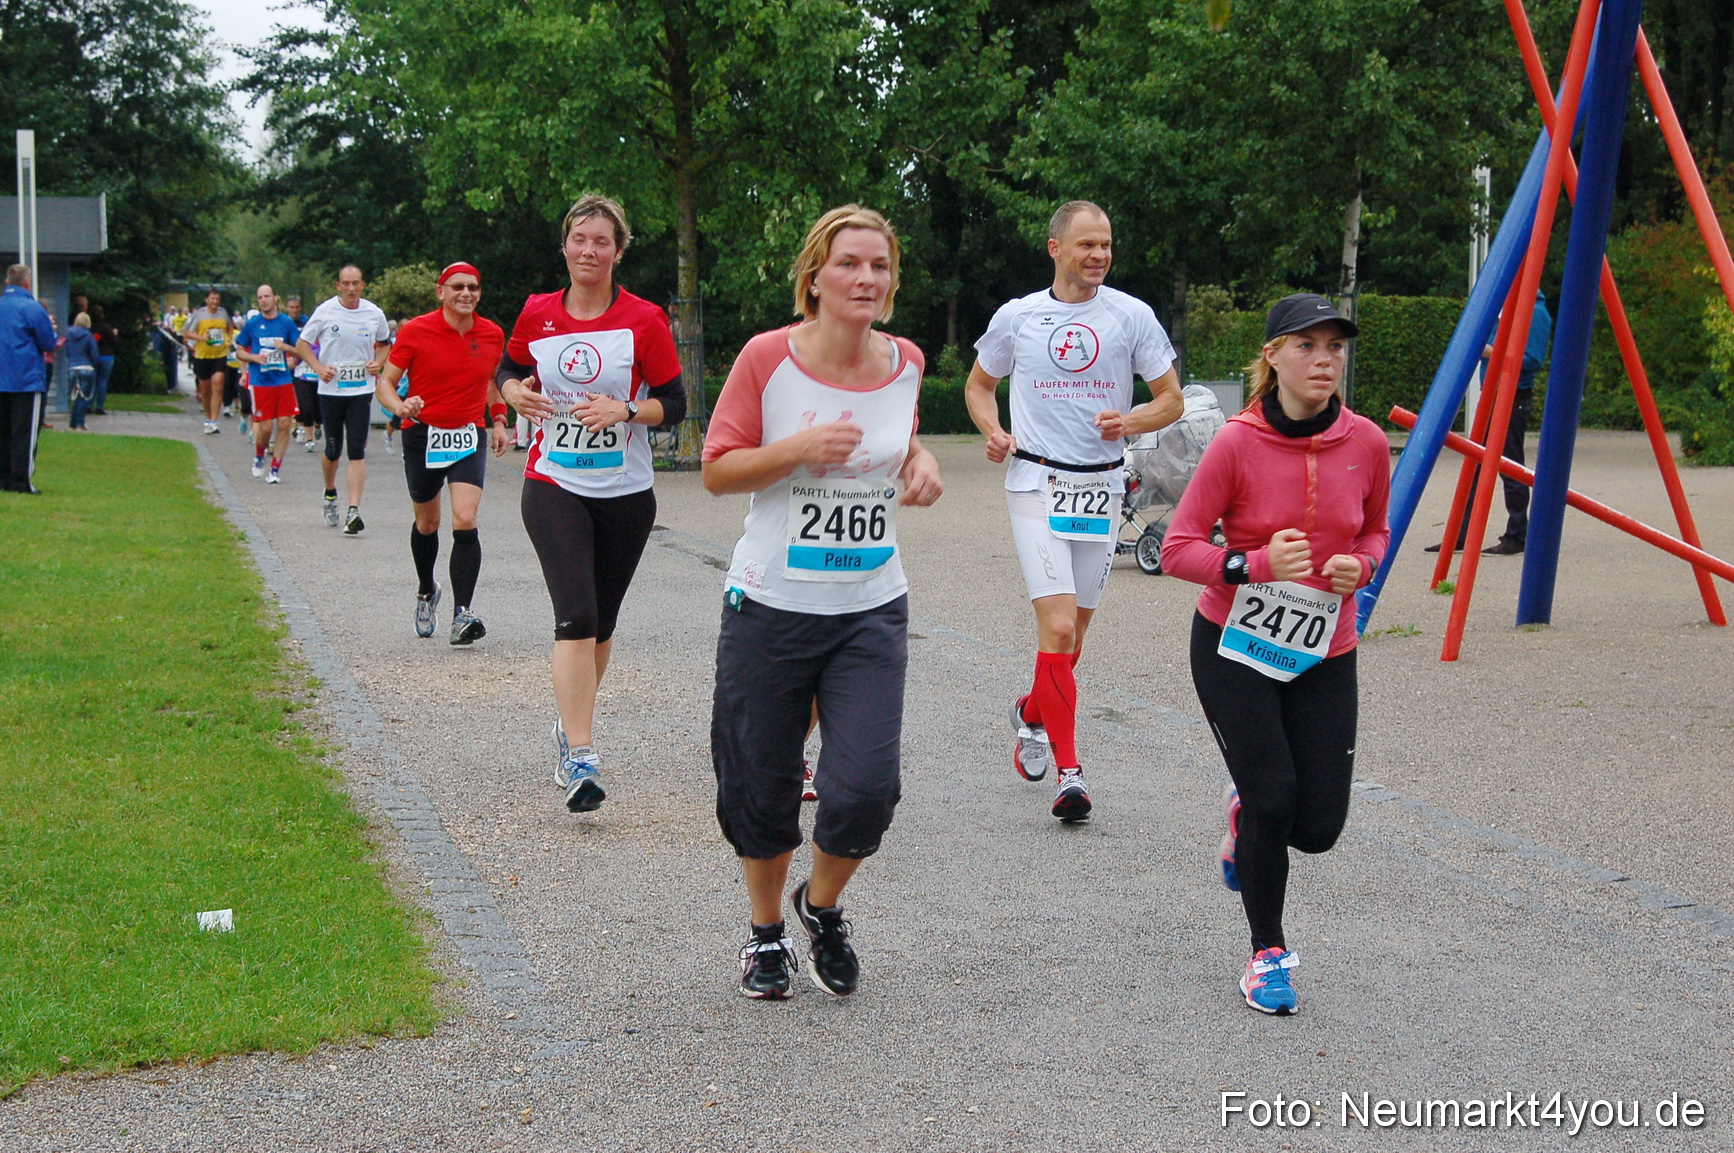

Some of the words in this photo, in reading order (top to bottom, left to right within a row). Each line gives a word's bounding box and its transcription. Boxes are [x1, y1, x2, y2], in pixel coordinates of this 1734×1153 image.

[340, 368, 366, 380] 2144
[1033, 379, 1069, 389] LAUFEN
[1093, 379, 1116, 389] HERZ
[431, 432, 473, 449] 2099
[556, 421, 617, 449] 2725
[576, 456, 594, 467] Eva
[792, 486, 830, 499] PARTL
[832, 489, 880, 499] Neumarkt
[1073, 481, 1105, 490] Neumarkt
[1052, 490, 1110, 515] 2722
[799, 503, 886, 542] 2466
[1071, 521, 1089, 531] Knut
[825, 553, 862, 567] Petra
[1278, 589, 1326, 611] Neumarkt
[1239, 596, 1326, 649] 2470
[1246, 640, 1297, 669] Kristina
